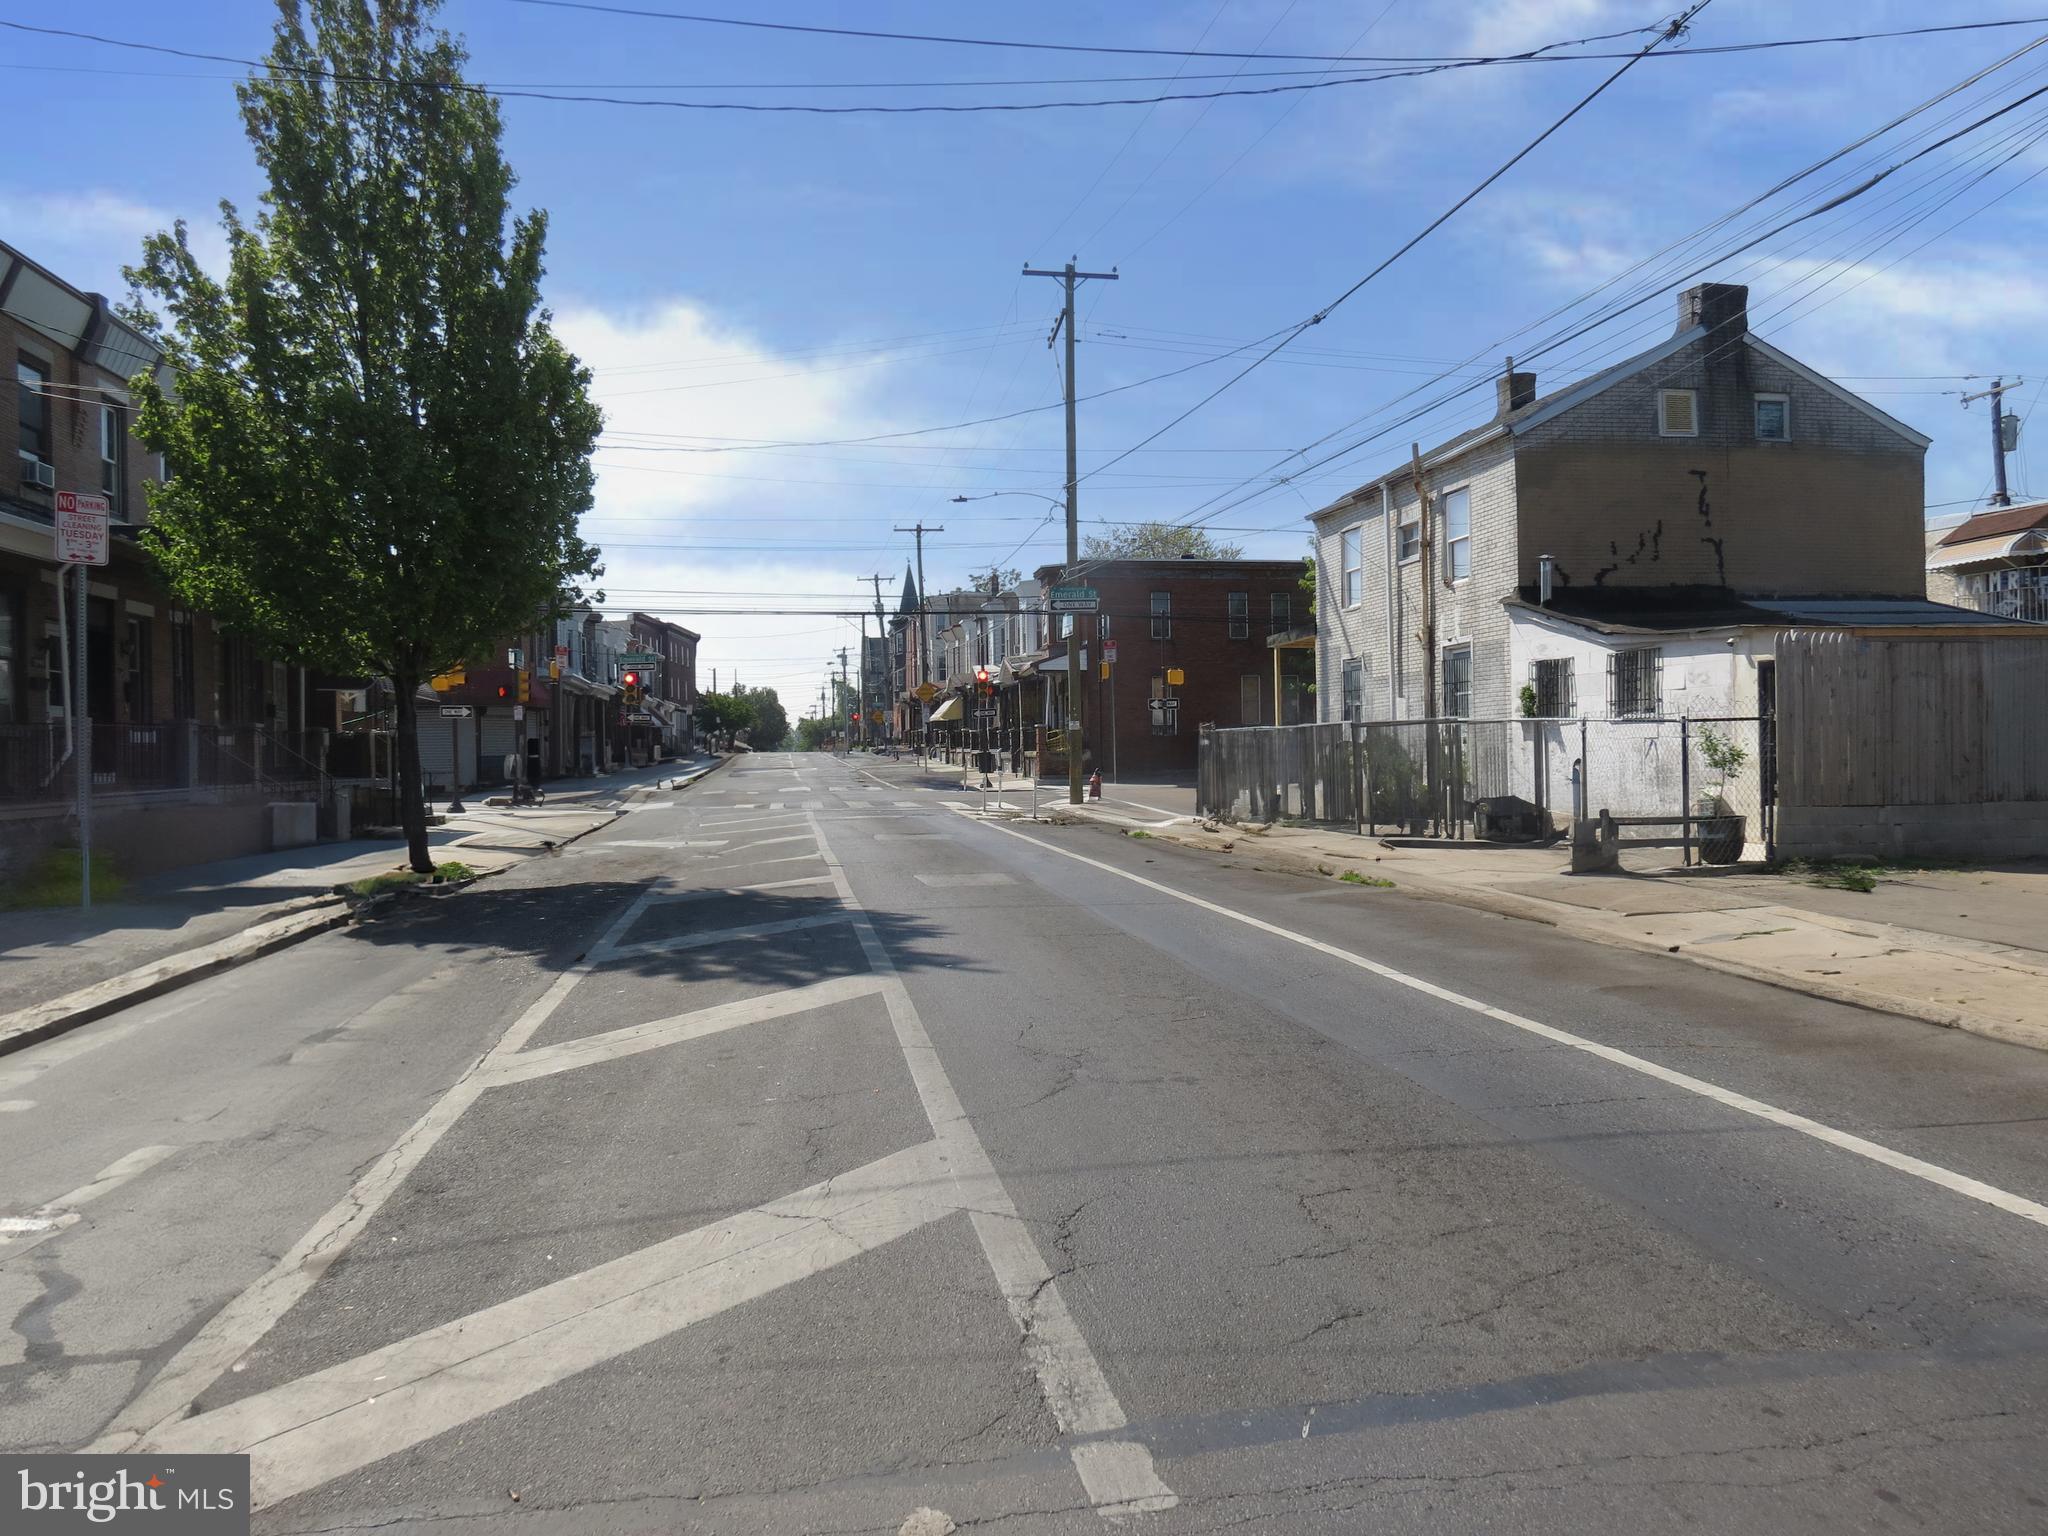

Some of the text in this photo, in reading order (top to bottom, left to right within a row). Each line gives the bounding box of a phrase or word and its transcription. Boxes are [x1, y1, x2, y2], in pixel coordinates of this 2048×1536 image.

[59, 495, 105, 511] NO PARKING
[68, 513, 97, 523] STREET
[63, 520, 102, 532] CLEANING
[60, 528, 104, 540] TUESDAY
[1051, 590, 1096, 599] Emerald St
